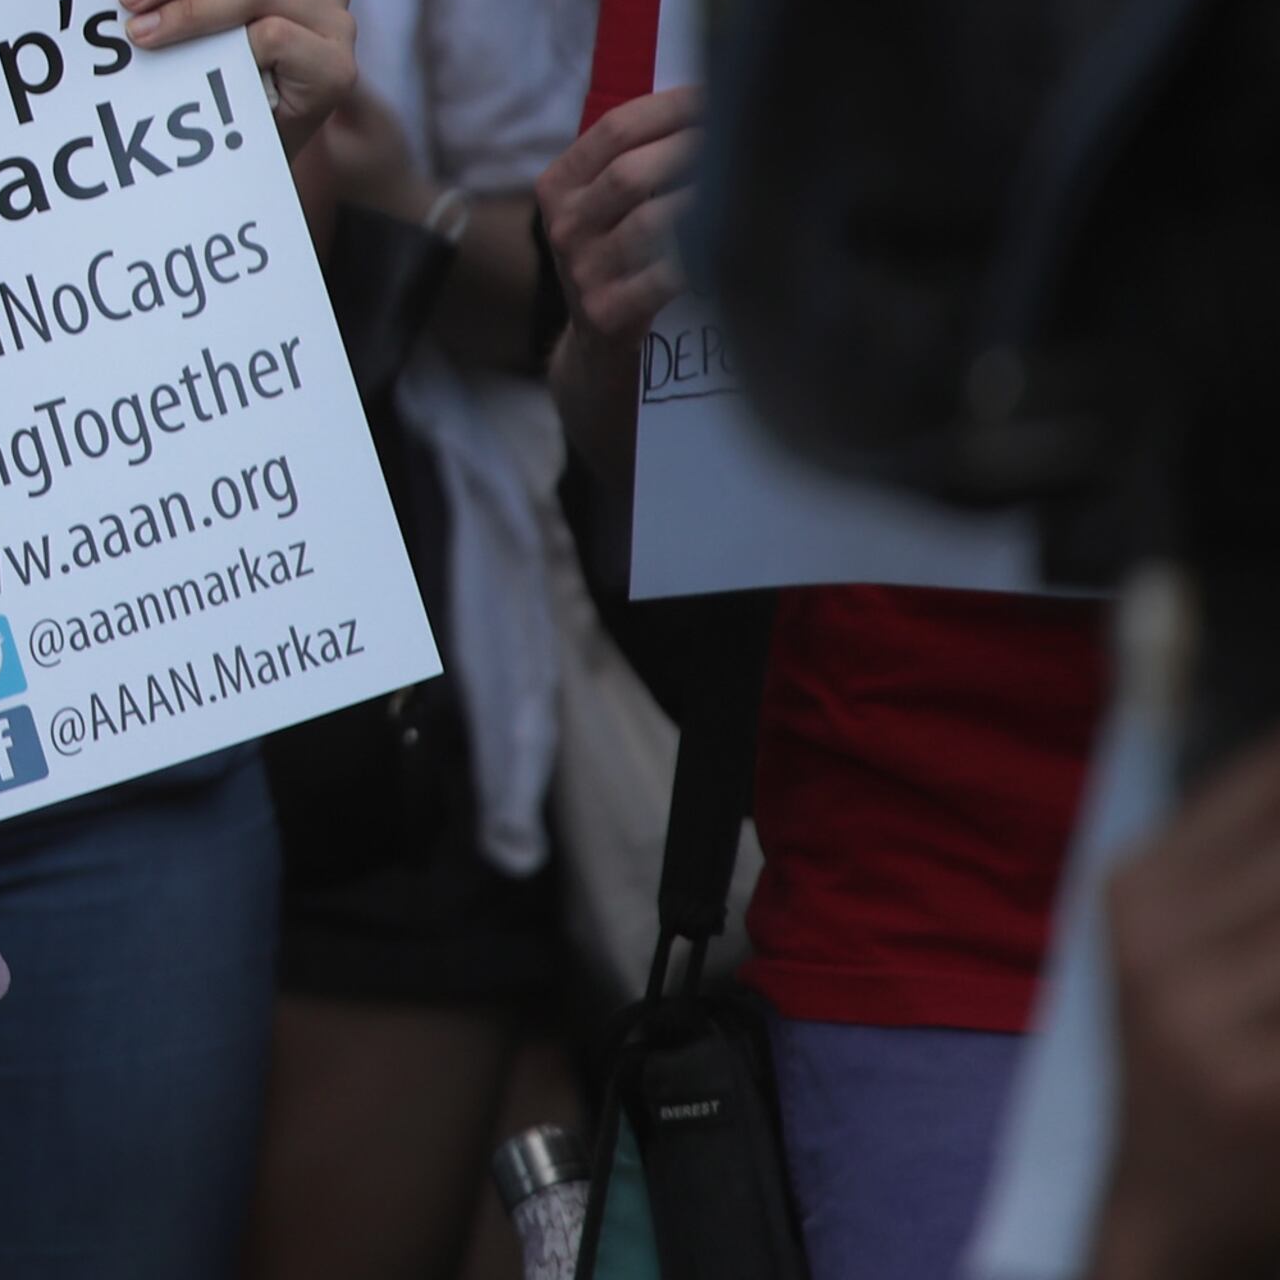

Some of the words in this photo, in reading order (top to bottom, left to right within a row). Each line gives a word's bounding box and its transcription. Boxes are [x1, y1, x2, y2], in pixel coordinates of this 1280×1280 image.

[27, 540, 315, 669] @aaanmarkaz
[49, 617, 365, 757] @AAAN.Markaz
[659, 1099, 721, 1120] EVEREST
